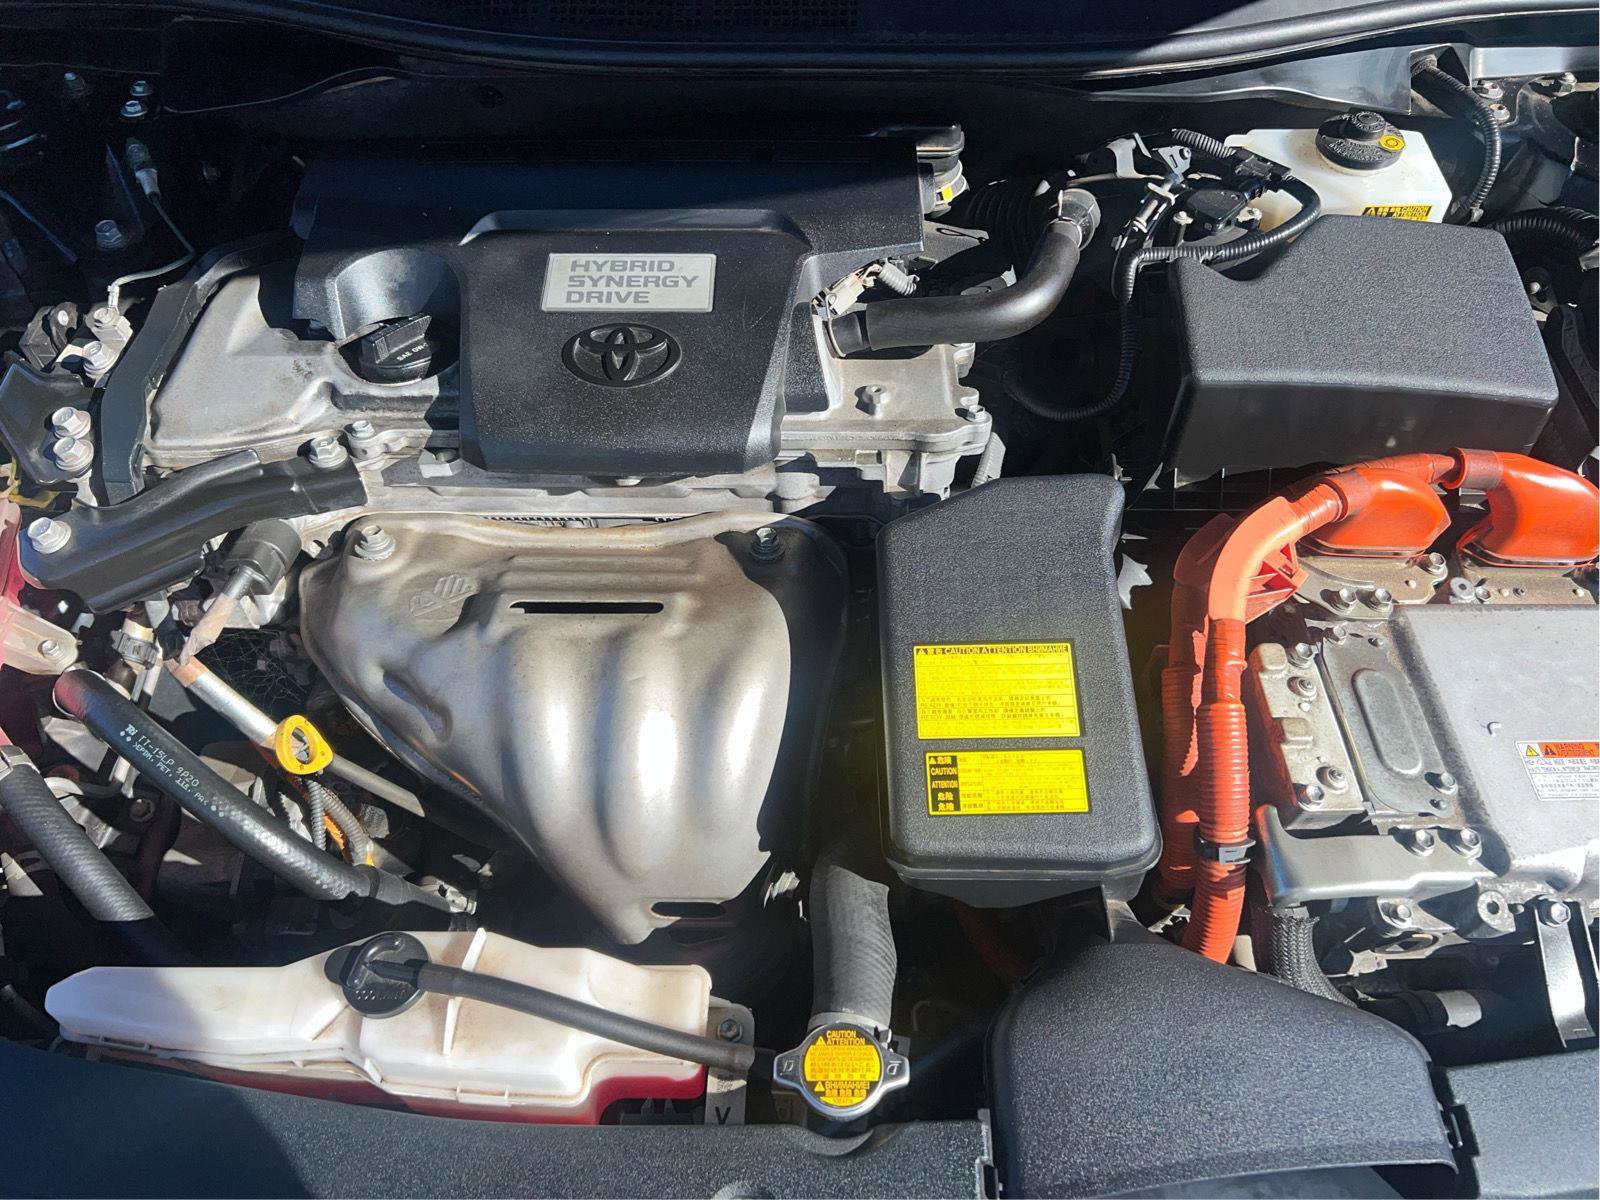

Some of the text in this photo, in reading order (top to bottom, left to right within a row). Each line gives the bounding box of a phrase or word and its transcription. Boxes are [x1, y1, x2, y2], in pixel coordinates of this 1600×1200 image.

[570, 260, 675, 272] HYBRID
[568, 275, 699, 288] SYNERGY
[566, 291, 650, 303] DRIVE
[944, 647, 980, 655] CAUTION
[981, 646, 1026, 654] ATTENTION
[931, 767, 958, 776] CAUTION
[932, 780, 959, 789] ATTENTION
[826, 1030, 857, 1038] CAUTION
[826, 1038, 865, 1046] ATTENTION
